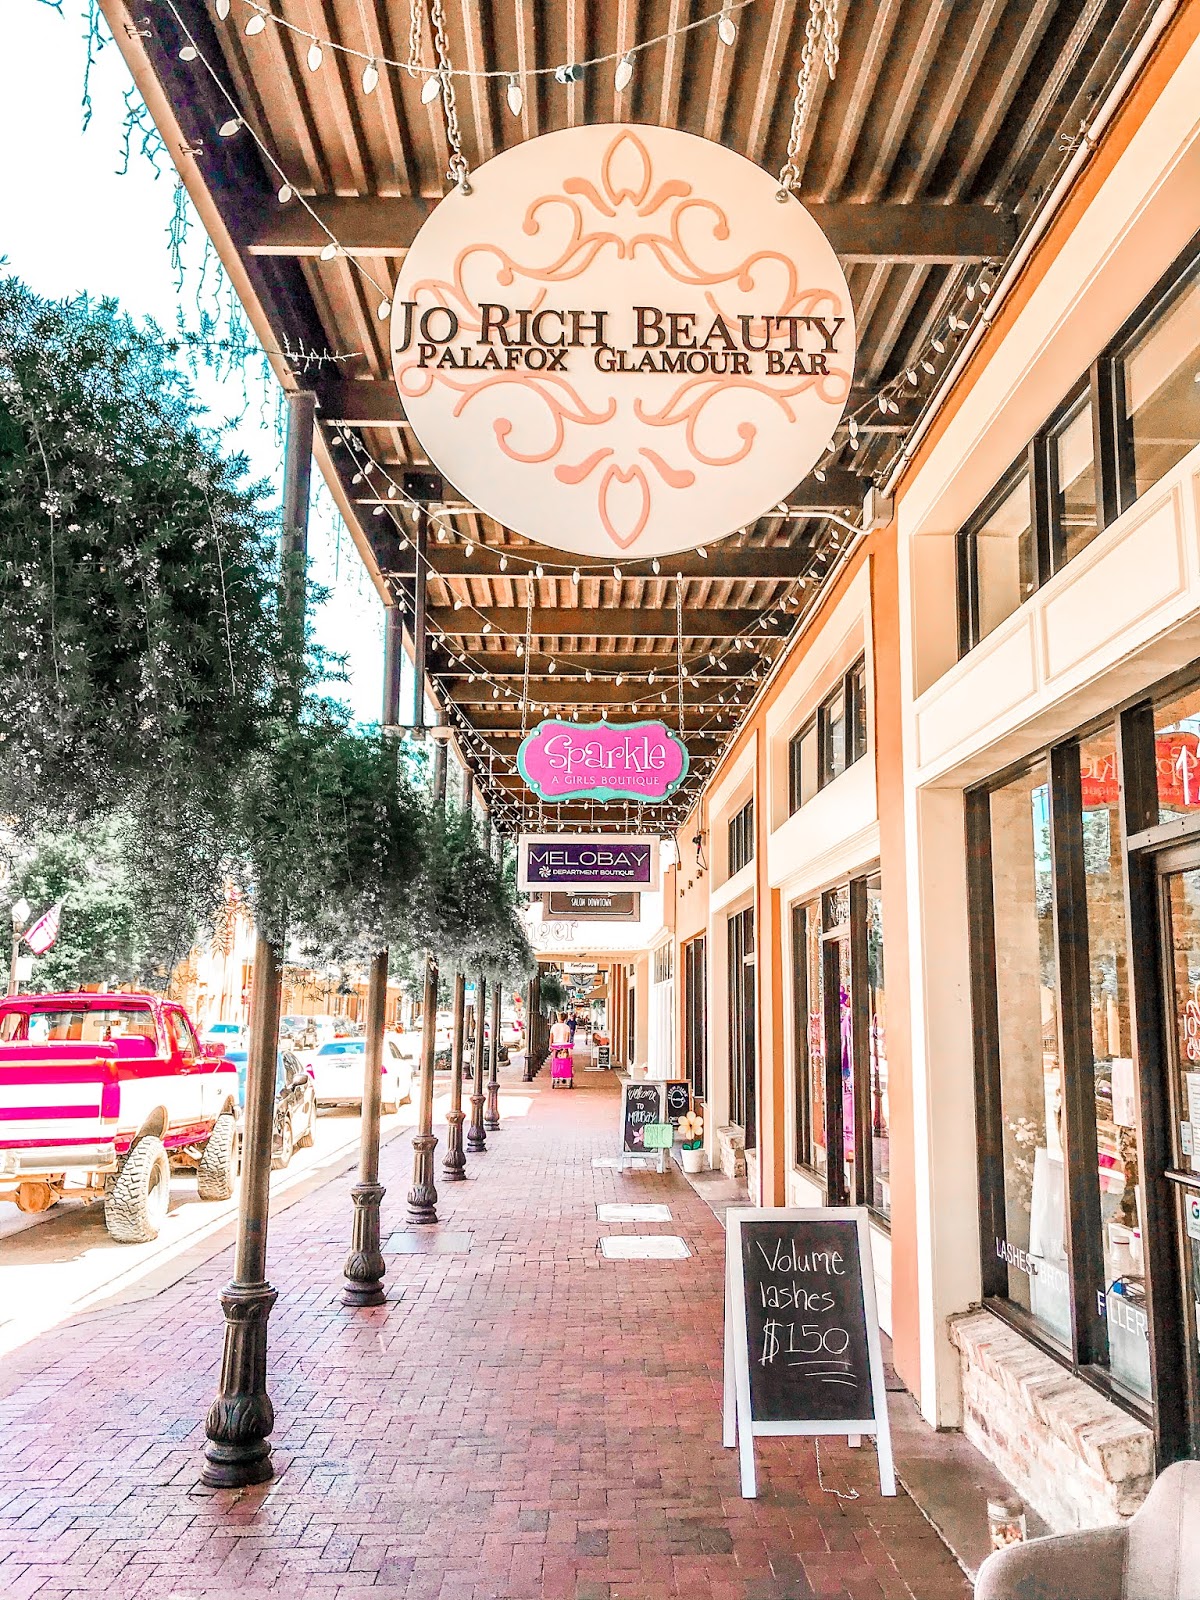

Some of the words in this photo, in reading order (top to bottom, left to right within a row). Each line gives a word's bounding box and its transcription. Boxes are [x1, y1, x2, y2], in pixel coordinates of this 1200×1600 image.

[476, 303, 609, 349] RICH
[632, 306, 845, 354] BEAUTY
[417, 343, 568, 372] PALAFOX
[594, 346, 752, 375] GLAMOUR
[766, 350, 830, 376] BAR
[543, 734, 666, 773] Sparkle
[551, 775, 559, 784] A
[564, 775, 596, 785] GIRLS
[601, 776, 660, 787] BOUTIQUE
[529, 851, 649, 867] MELOBAY
[600, 869, 635, 877] BOUTIQUE
[571, 898, 586, 907] SALON
[587, 898, 612, 907] DOWNTOWN
[756, 1238, 846, 1275] Volume
[995, 1236, 1032, 1276] LASHES
[760, 1280, 836, 1312] lashes
[758, 1318, 850, 1367] $150
